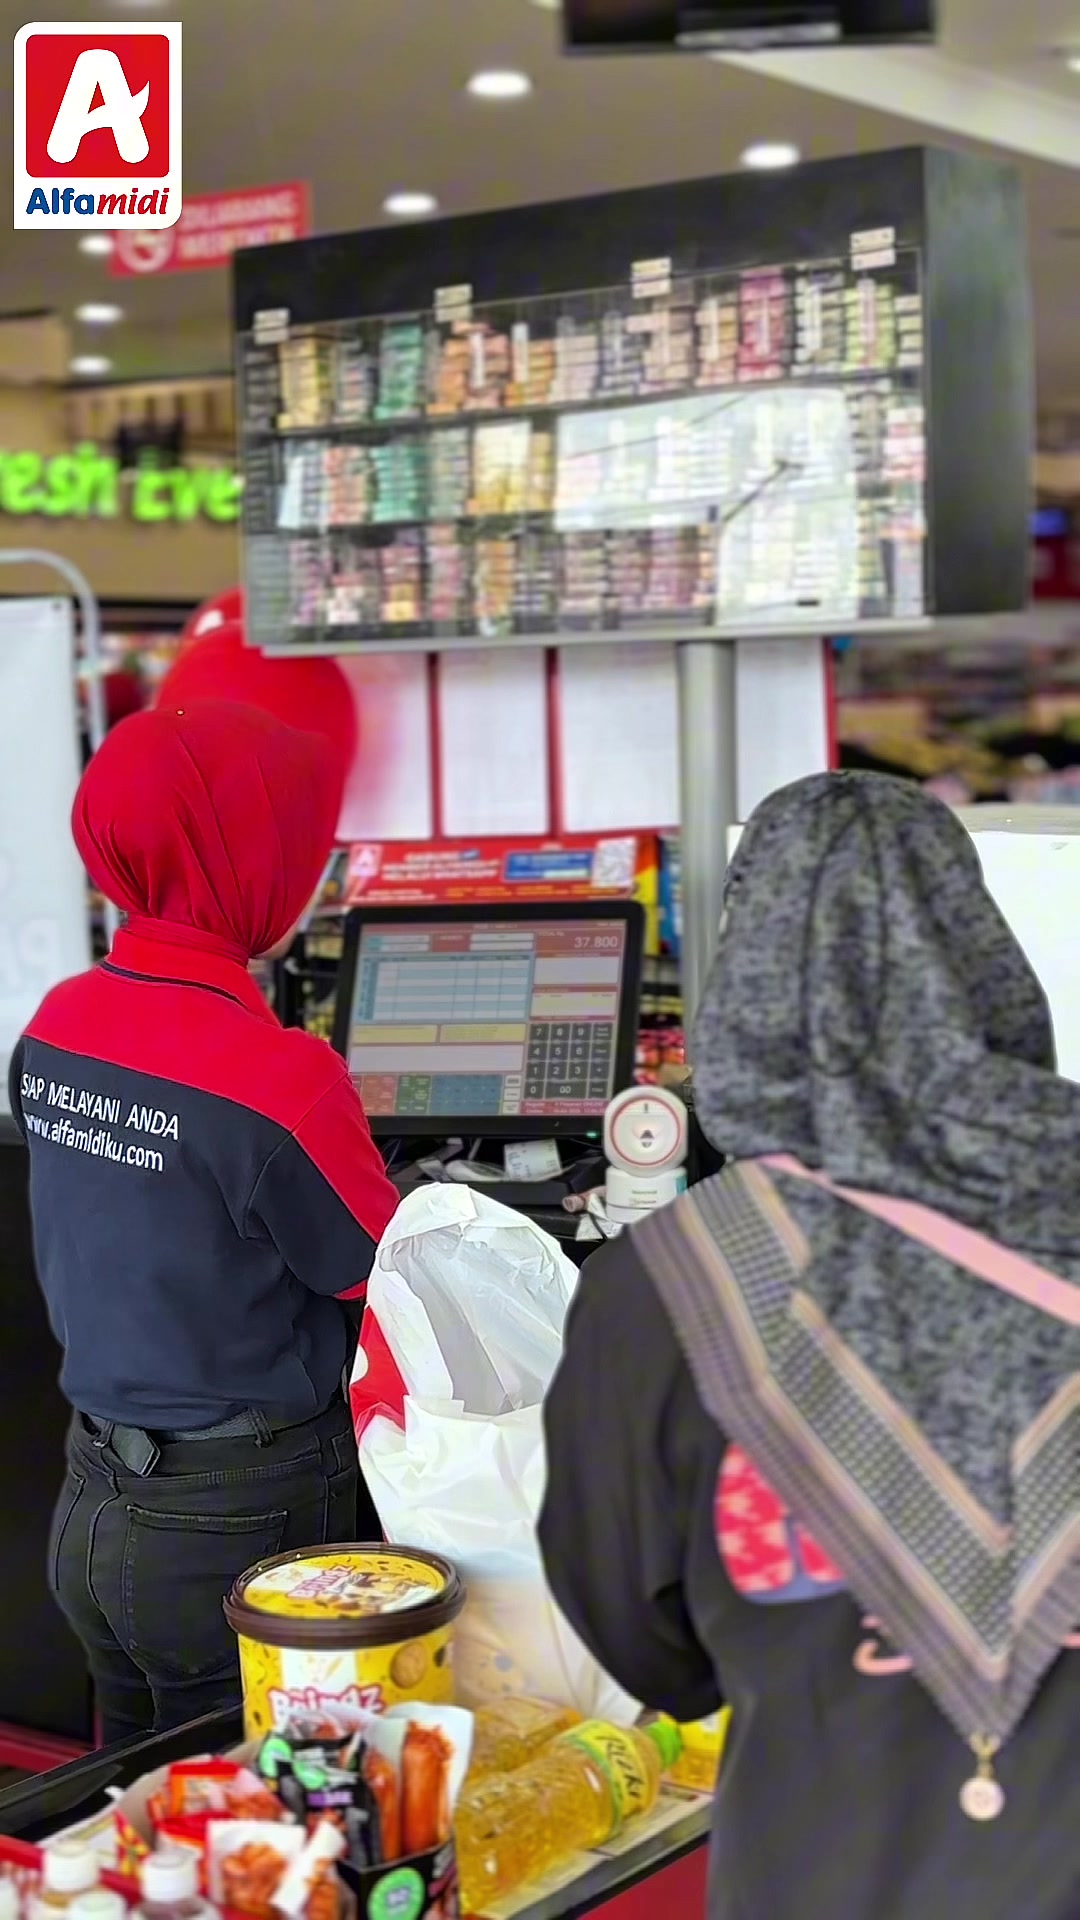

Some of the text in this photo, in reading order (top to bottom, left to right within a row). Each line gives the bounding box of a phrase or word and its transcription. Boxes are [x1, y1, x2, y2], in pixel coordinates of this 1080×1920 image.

[573, 936, 619, 949] 37.800
[560, 1086, 571, 1094] 00
[20, 1072, 179, 1140] SIAP MELAYANI ANDA
